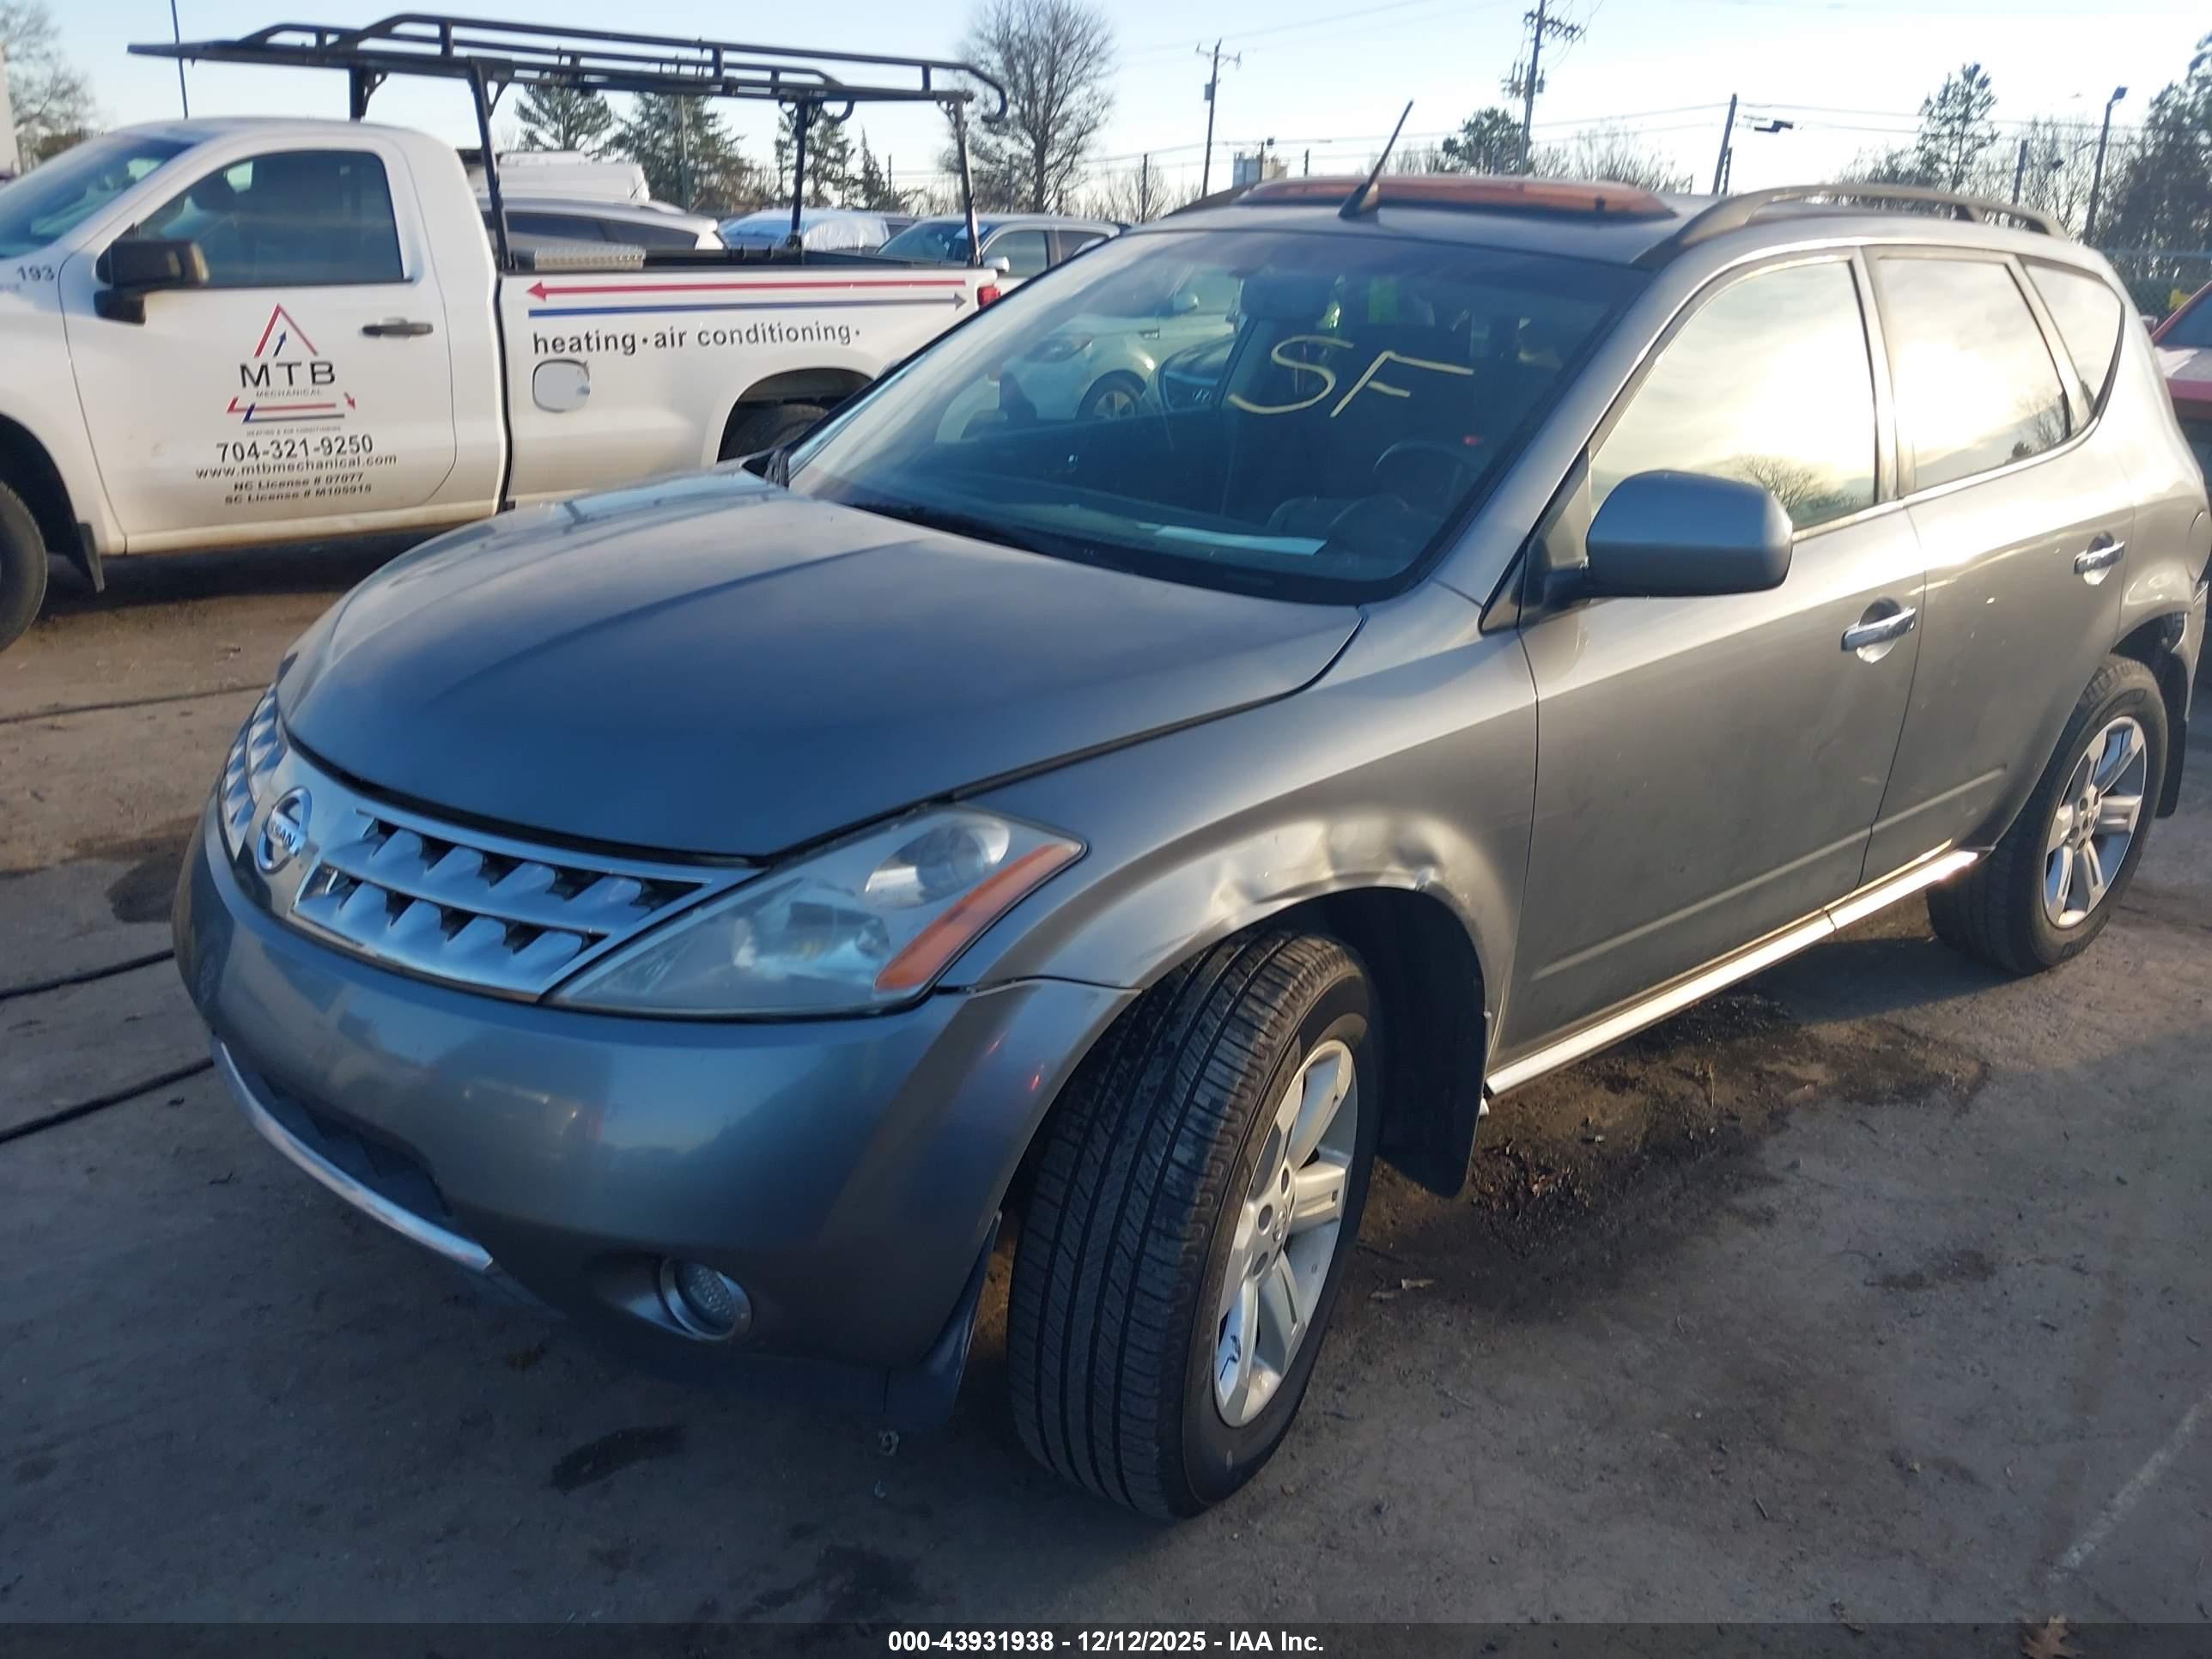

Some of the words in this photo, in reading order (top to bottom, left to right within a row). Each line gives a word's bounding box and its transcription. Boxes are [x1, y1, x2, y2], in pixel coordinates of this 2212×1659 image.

[16, 264, 55, 283] 193
[240, 362, 336, 389] MTB
[1228, 334, 1475, 419] SF
[256, 388, 323, 399] MECHANICAL
[216, 434, 374, 464] 704-321-9250
[196, 454, 397, 479] www.mtbmechanical.com
[234, 481, 253, 492] NC
[258, 478, 309, 491] License
[247, 490, 300, 504] License
